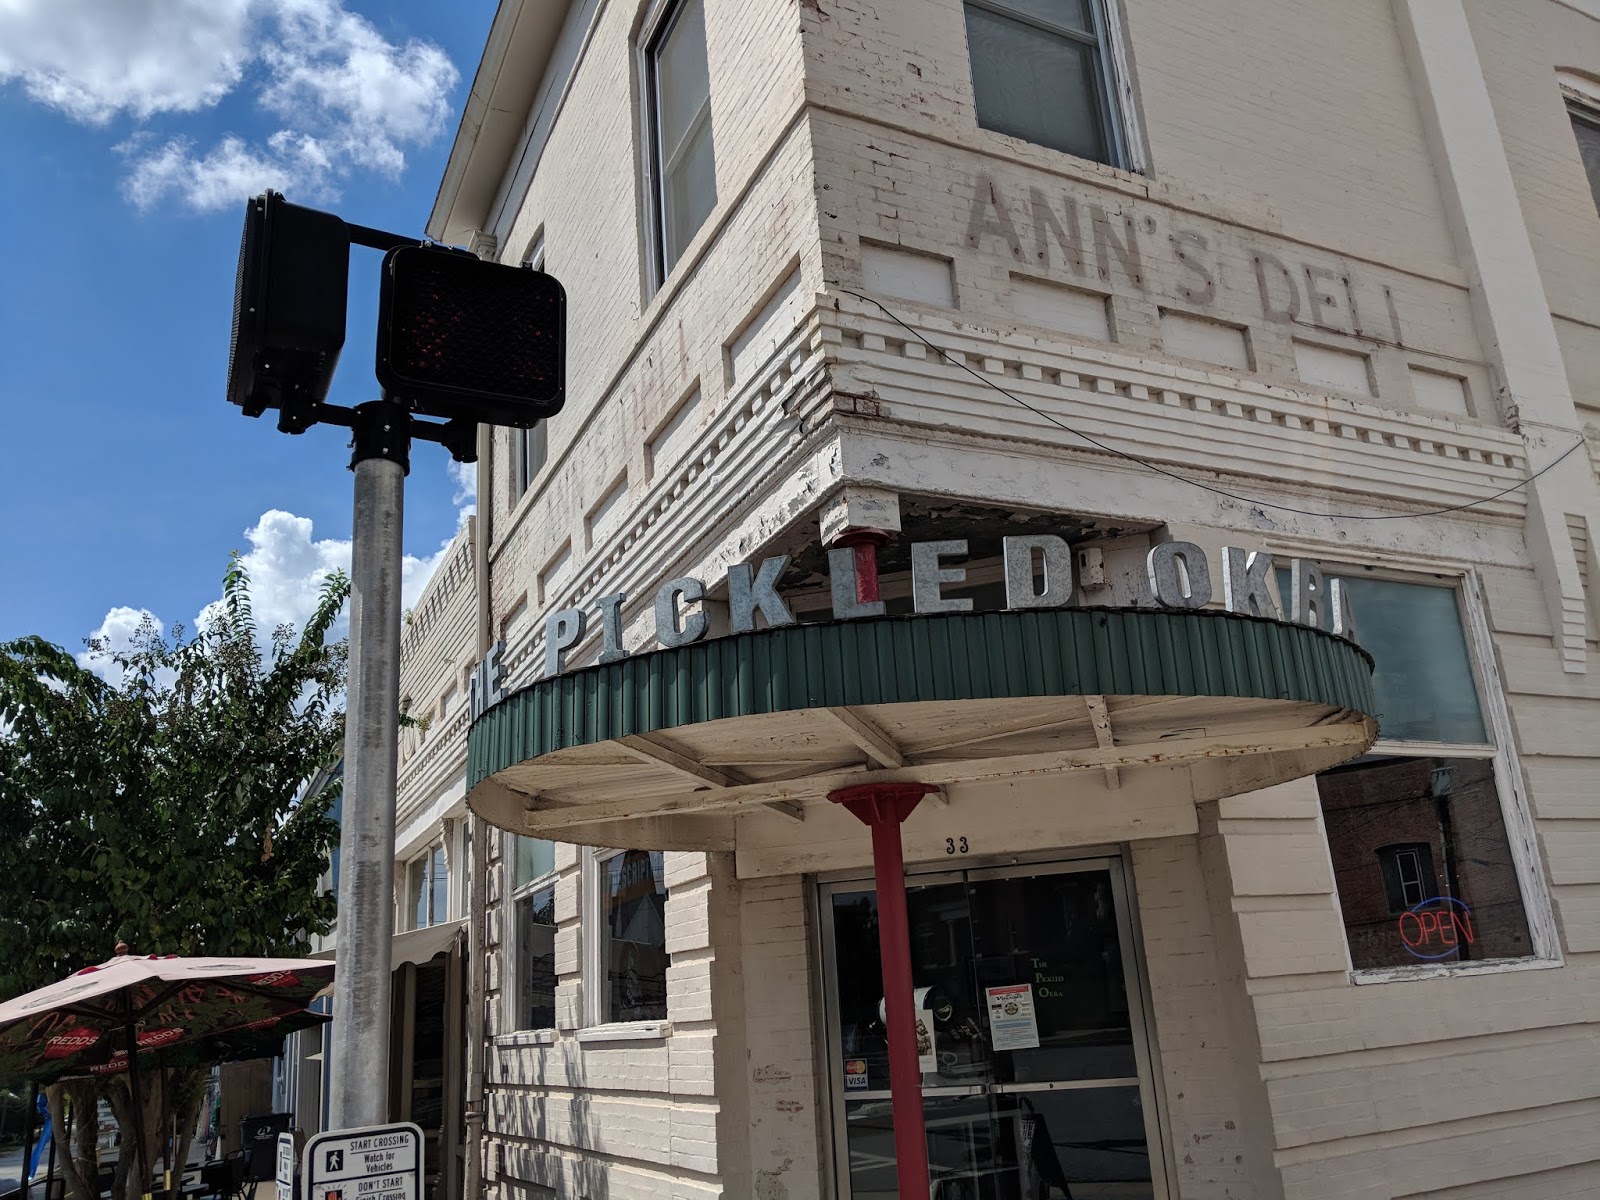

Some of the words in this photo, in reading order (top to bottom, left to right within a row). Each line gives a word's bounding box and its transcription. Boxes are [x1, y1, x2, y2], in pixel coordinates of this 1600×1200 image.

[963, 174, 1216, 305] ANN'S
[1250, 248, 1404, 348] DELI
[544, 534, 1073, 678] PICKLED
[1146, 541, 1356, 642] OKRA
[946, 836, 968, 854] 33
[1399, 911, 1474, 946] OPEN
[848, 1077, 866, 1085] VISA
[350, 1139, 371, 1151] START
[373, 1134, 409, 1148] CROSSING
[364, 1152, 384, 1164] Watch
[385, 1151, 395, 1161] for
[366, 1162, 393, 1173] Vehicles
[358, 1180, 380, 1192] DON'T
[382, 1177, 403, 1188] START
